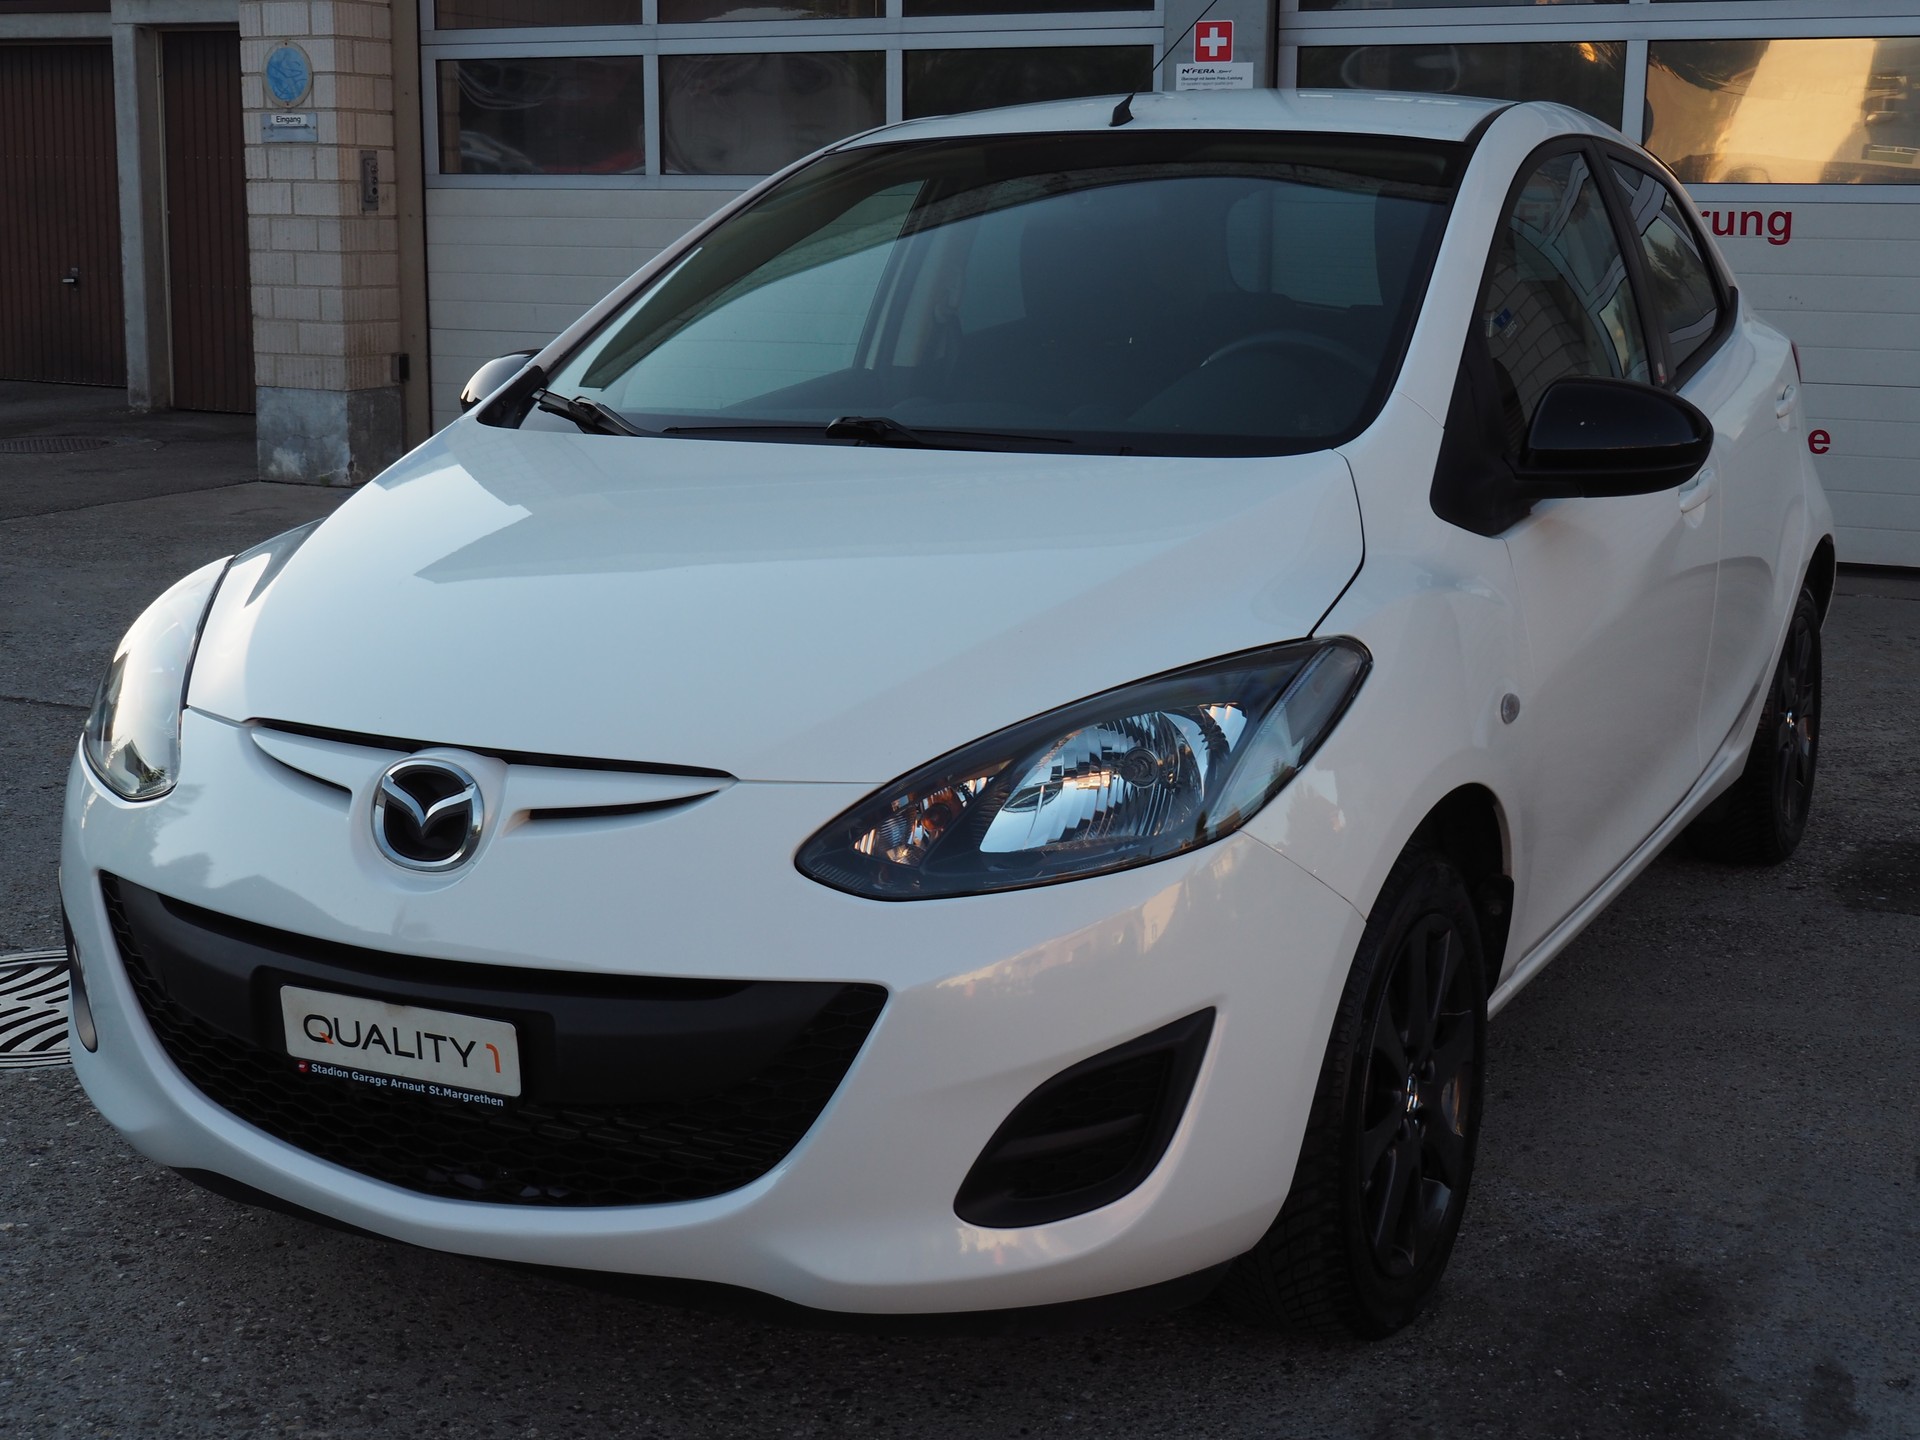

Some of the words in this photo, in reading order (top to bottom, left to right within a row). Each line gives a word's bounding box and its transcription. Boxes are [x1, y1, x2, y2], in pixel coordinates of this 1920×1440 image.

[275, 116, 301, 124] Eingang
[1701, 210, 1792, 246] ung
[303, 1014, 477, 1067] QUALITY
[485, 1042, 501, 1074] 1
[311, 1063, 349, 1078] Stadion
[351, 1071, 388, 1087] Garage
[390, 1078, 426, 1093] Arnaut
[429, 1085, 504, 1106] St.Margrethen
